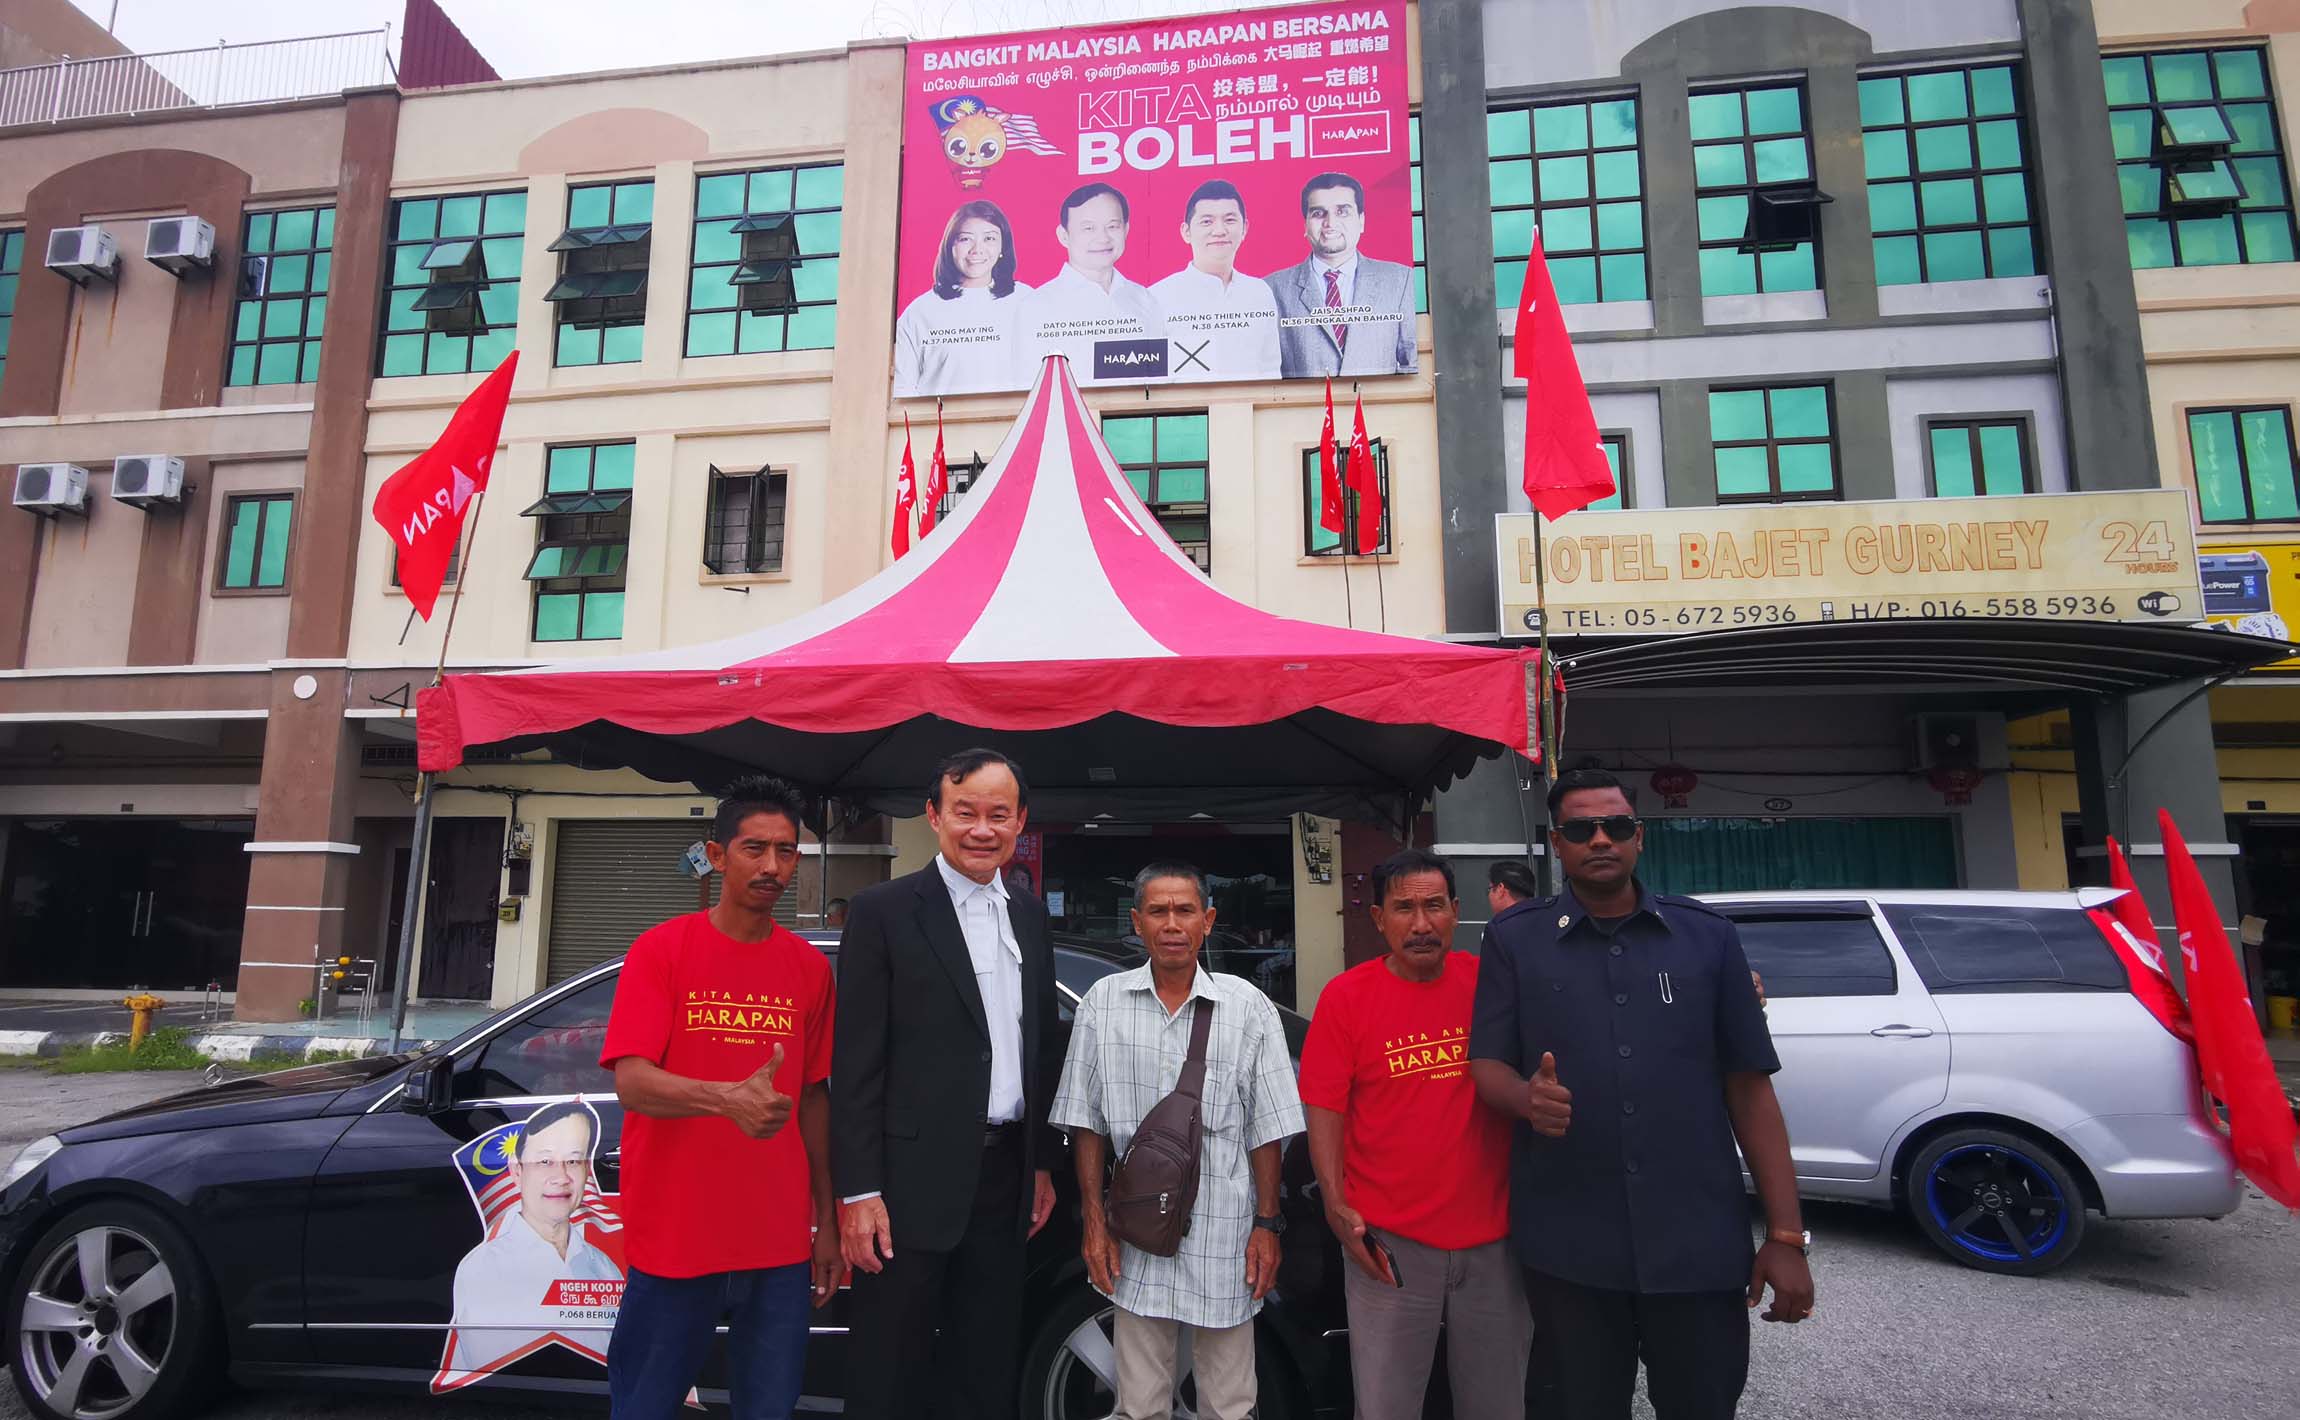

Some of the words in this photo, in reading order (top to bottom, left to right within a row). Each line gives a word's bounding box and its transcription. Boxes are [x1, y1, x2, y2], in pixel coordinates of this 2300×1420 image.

[923, 45, 1022, 71] BANGKIT
[1027, 35, 1141, 62] MALAYSIA
[1153, 22, 1266, 51] HARAPAN
[1273, 10, 1389, 39] BERSAMA
[1263, 42, 1322, 62] 大马崛起
[1330, 35, 1389, 57] 重燃希望
[923, 72, 1019, 92] மலேசியாவின்
[1187, 52, 1257, 73] நம்பிக்கை
[1078, 83, 1212, 130] KITA
[1215, 94, 1298, 121] நம்மால்
[1306, 87, 1381, 112] முடியும்
[1322, 127, 1379, 141] HARAPAN
[1078, 114, 1305, 175] BOLEH
[1168, 315, 1197, 323] JASON
[1215, 312, 1241, 320] THIEN
[1243, 310, 1275, 319] YEONG
[1311, 307, 1332, 315] JAIS
[1333, 306, 1372, 314] ASHFAQ
[1043, 322, 1067, 330] DATO
[1069, 320, 1093, 328] NGEH
[1095, 319, 1115, 327] KOO
[1116, 318, 1137, 326] HAM
[1192, 322, 1211, 330] N.38
[1213, 321, 1250, 329] ASTAKA
[1282, 318, 1302, 326] N.36
[1304, 315, 1361, 325] PENGKALAN
[1363, 313, 1403, 322] BAHARU
[959, 327, 977, 335] MAY
[1037, 330, 1061, 338] P.068
[1062, 328, 1107, 337] PARLIMEN
[1108, 326, 1144, 335] BERUAS
[942, 336, 974, 344] PANTAI
[1103, 350, 1160, 366] HARAPAN
[2102, 520, 2174, 563] 24
[1517, 534, 1668, 584] HOTEL
[1679, 528, 1829, 580] BAJET
[1845, 520, 2049, 575] GURNEY
[2126, 562, 2178, 575] HOURS
[2203, 582, 2241, 590] uePower
[1851, 602, 1911, 620] H/P:
[2046, 596, 2115, 615] 5936
[1562, 608, 1616, 628] TEL:
[689, 991, 731, 1000] KITA
[746, 993, 793, 1007] ANAK
[687, 1009, 792, 1030] HARAPAN
[724, 1037, 755, 1045] MALAYSIA
[1386, 1033, 1427, 1049] KITA
[1443, 1027, 1463, 1037] AN
[560, 1282, 588, 1292] NGEH
[591, 1283, 613, 1292] KOO
[560, 1311, 584, 1319] P.068
[586, 1311, 617, 1319] BERUA
